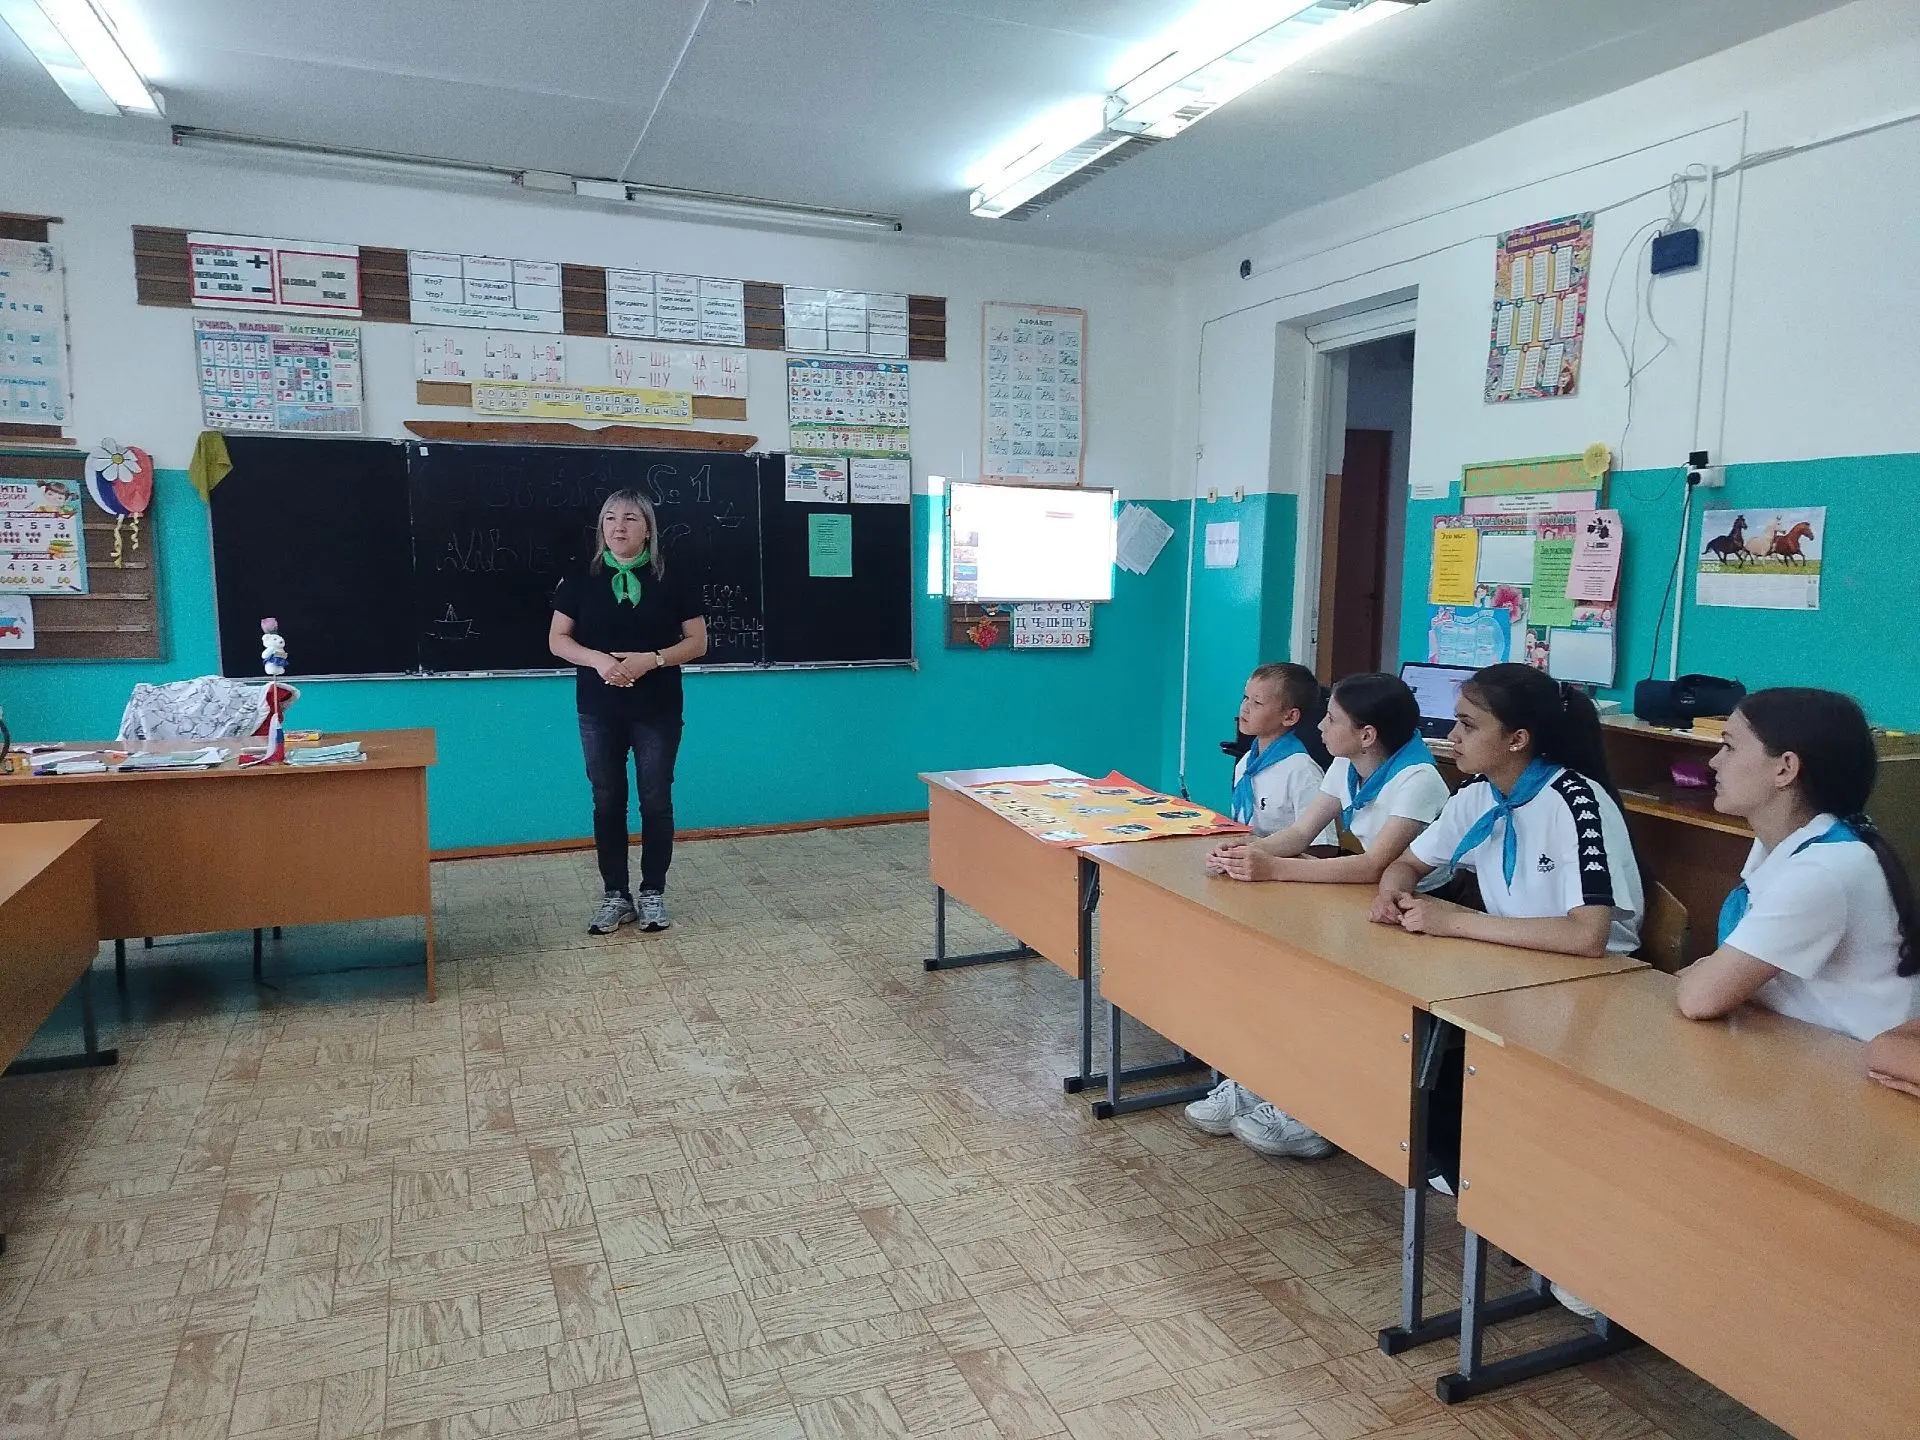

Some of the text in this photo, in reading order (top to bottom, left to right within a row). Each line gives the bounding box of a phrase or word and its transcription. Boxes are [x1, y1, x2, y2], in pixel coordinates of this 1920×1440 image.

[424, 278, 443, 286] Кто?
[1019, 318, 1053, 327] АЛФАВИТ
[289, 325, 358, 337] МАТЕМАТИКА
[217, 342, 225, 351] 2
[231, 343, 238, 351] 3
[244, 343, 251, 351] 4
[259, 344, 266, 353] 5
[692, 351, 707, 370] ЧА
[205, 368, 212, 377] 6
[219, 369, 226, 377] 7
[233, 369, 240, 378] 8
[247, 371, 254, 379] 9
[615, 368, 670, 388] ЧУ ШУ
[689, 464, 711, 504] 1
[4, 521, 12, 530] 8
[30, 521, 37, 530] 5
[57, 522, 65, 530] 3
[31, 563, 39, 571] 2
[59, 563, 66, 571] 2
[1701, 563, 1721, 572] 2026
[1061, 602, 1073, 611] Ф
[1077, 602, 1086, 611] Х
[1016, 617, 1027, 630] Ц
[1031, 617, 1041, 628] Ч
[1061, 617, 1073, 630] Щ
[1076, 617, 1087, 628] Ъ
[1031, 634, 1040, 644] Ь
[1045, 634, 1054, 645] Э
[1061, 633, 1073, 644] Ю
[1076, 633, 1086, 644] Я
